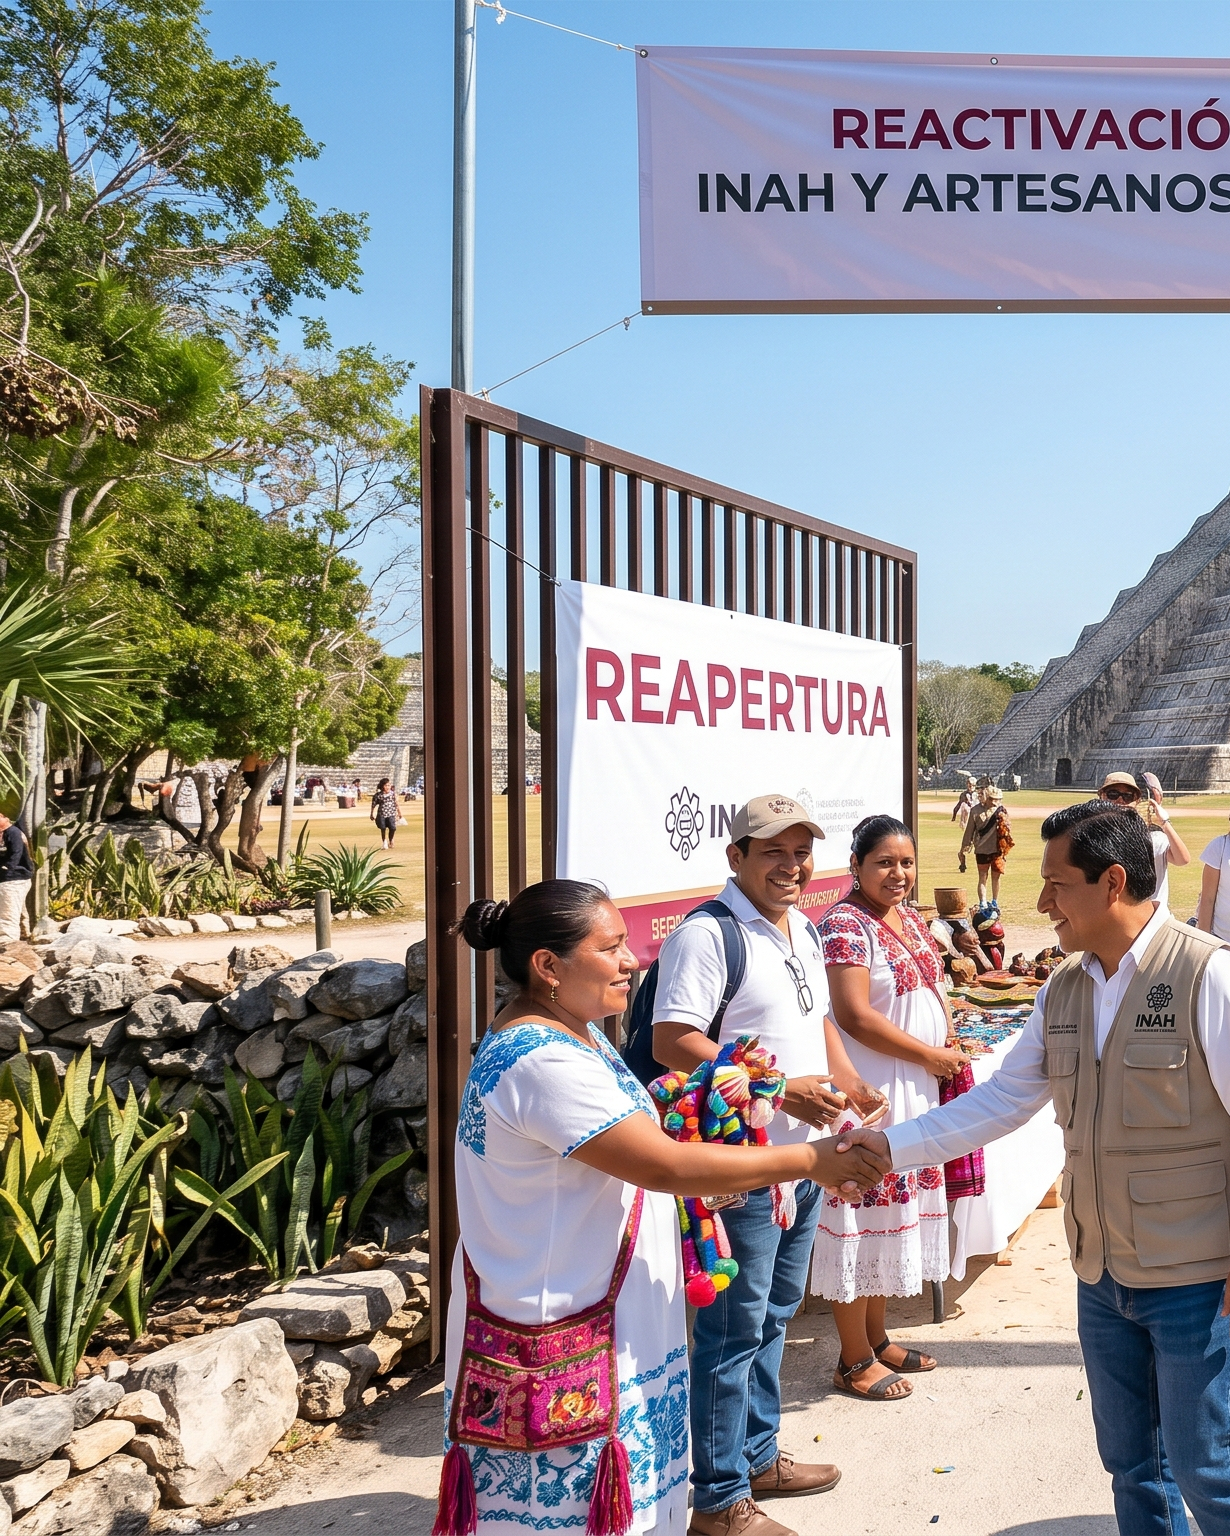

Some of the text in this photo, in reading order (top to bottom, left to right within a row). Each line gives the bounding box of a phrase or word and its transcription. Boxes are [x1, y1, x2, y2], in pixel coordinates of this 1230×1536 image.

[698, 173, 834, 213] INAH
[851, 173, 890, 213] Y
[586, 647, 891, 738] REAPERTURA
[710, 804, 736, 838] IN
[1135, 1013, 1175, 1028] INAH
